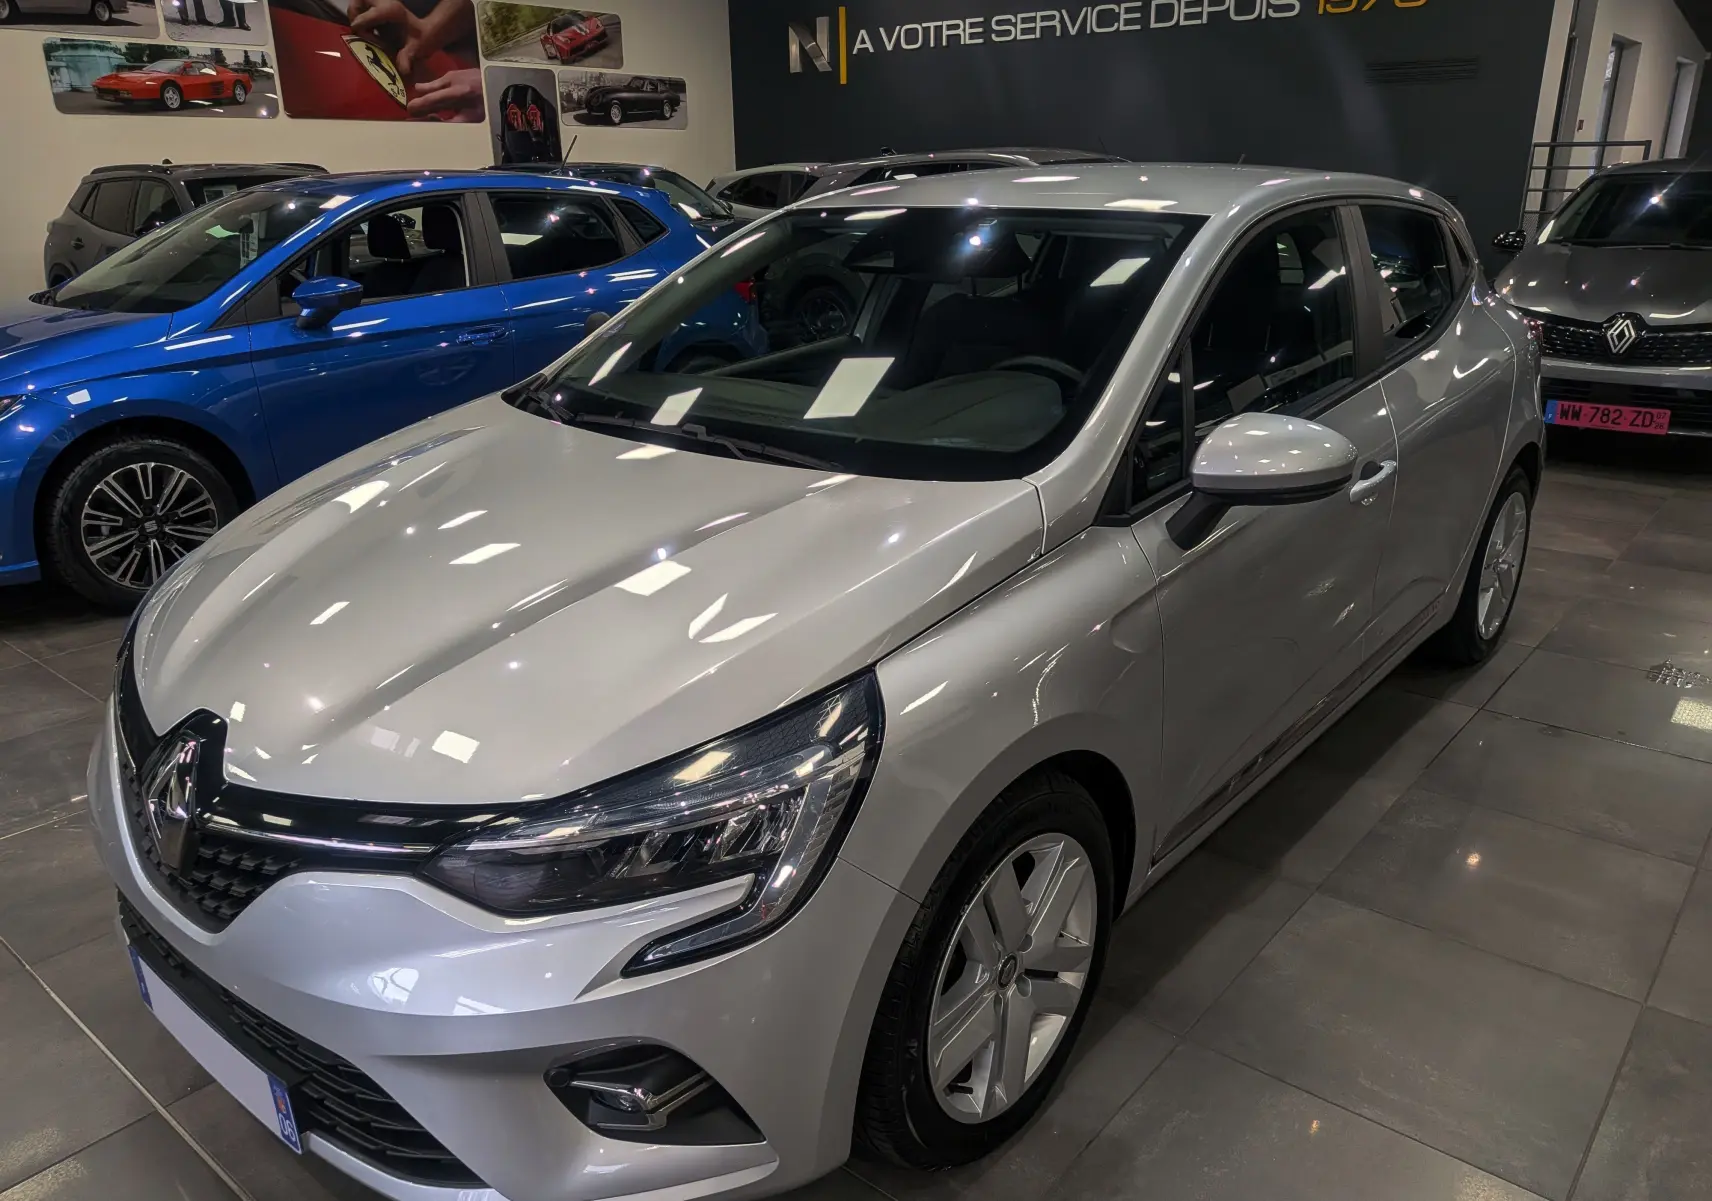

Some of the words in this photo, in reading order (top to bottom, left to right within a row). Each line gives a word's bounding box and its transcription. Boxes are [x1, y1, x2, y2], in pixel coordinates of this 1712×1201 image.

[852, 29, 875, 55] A
[879, 17, 985, 51] VOTRE
[991, 2, 1142, 42] SERVICE
[1150, 0, 1300, 29] DEPUIS
[278, 1112, 296, 1142] 06
